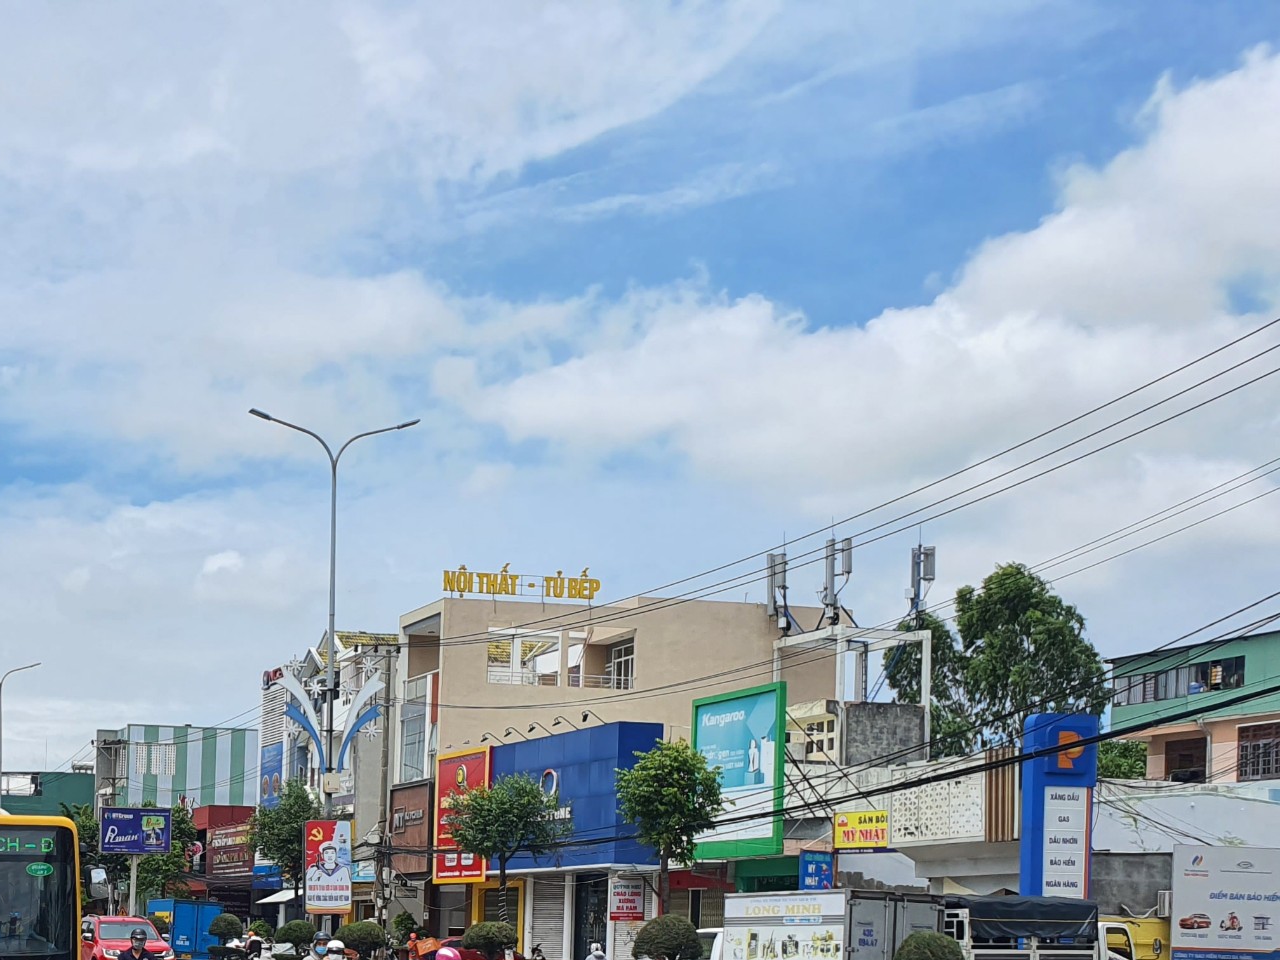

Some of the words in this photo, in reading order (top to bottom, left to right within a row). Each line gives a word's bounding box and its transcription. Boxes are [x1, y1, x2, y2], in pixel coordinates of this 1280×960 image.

[443, 564, 474, 598] NỘI
[476, 562, 519, 595] THẤT
[544, 570, 566, 598] TỦ
[567, 567, 601, 600] BẾP
[702, 710, 745, 727] Kangaroo
[842, 827, 857, 842] MỸ
[859, 826, 887, 846] NHẬT
[744, 905, 781, 916] LONG
[784, 903, 823, 915] MINH
